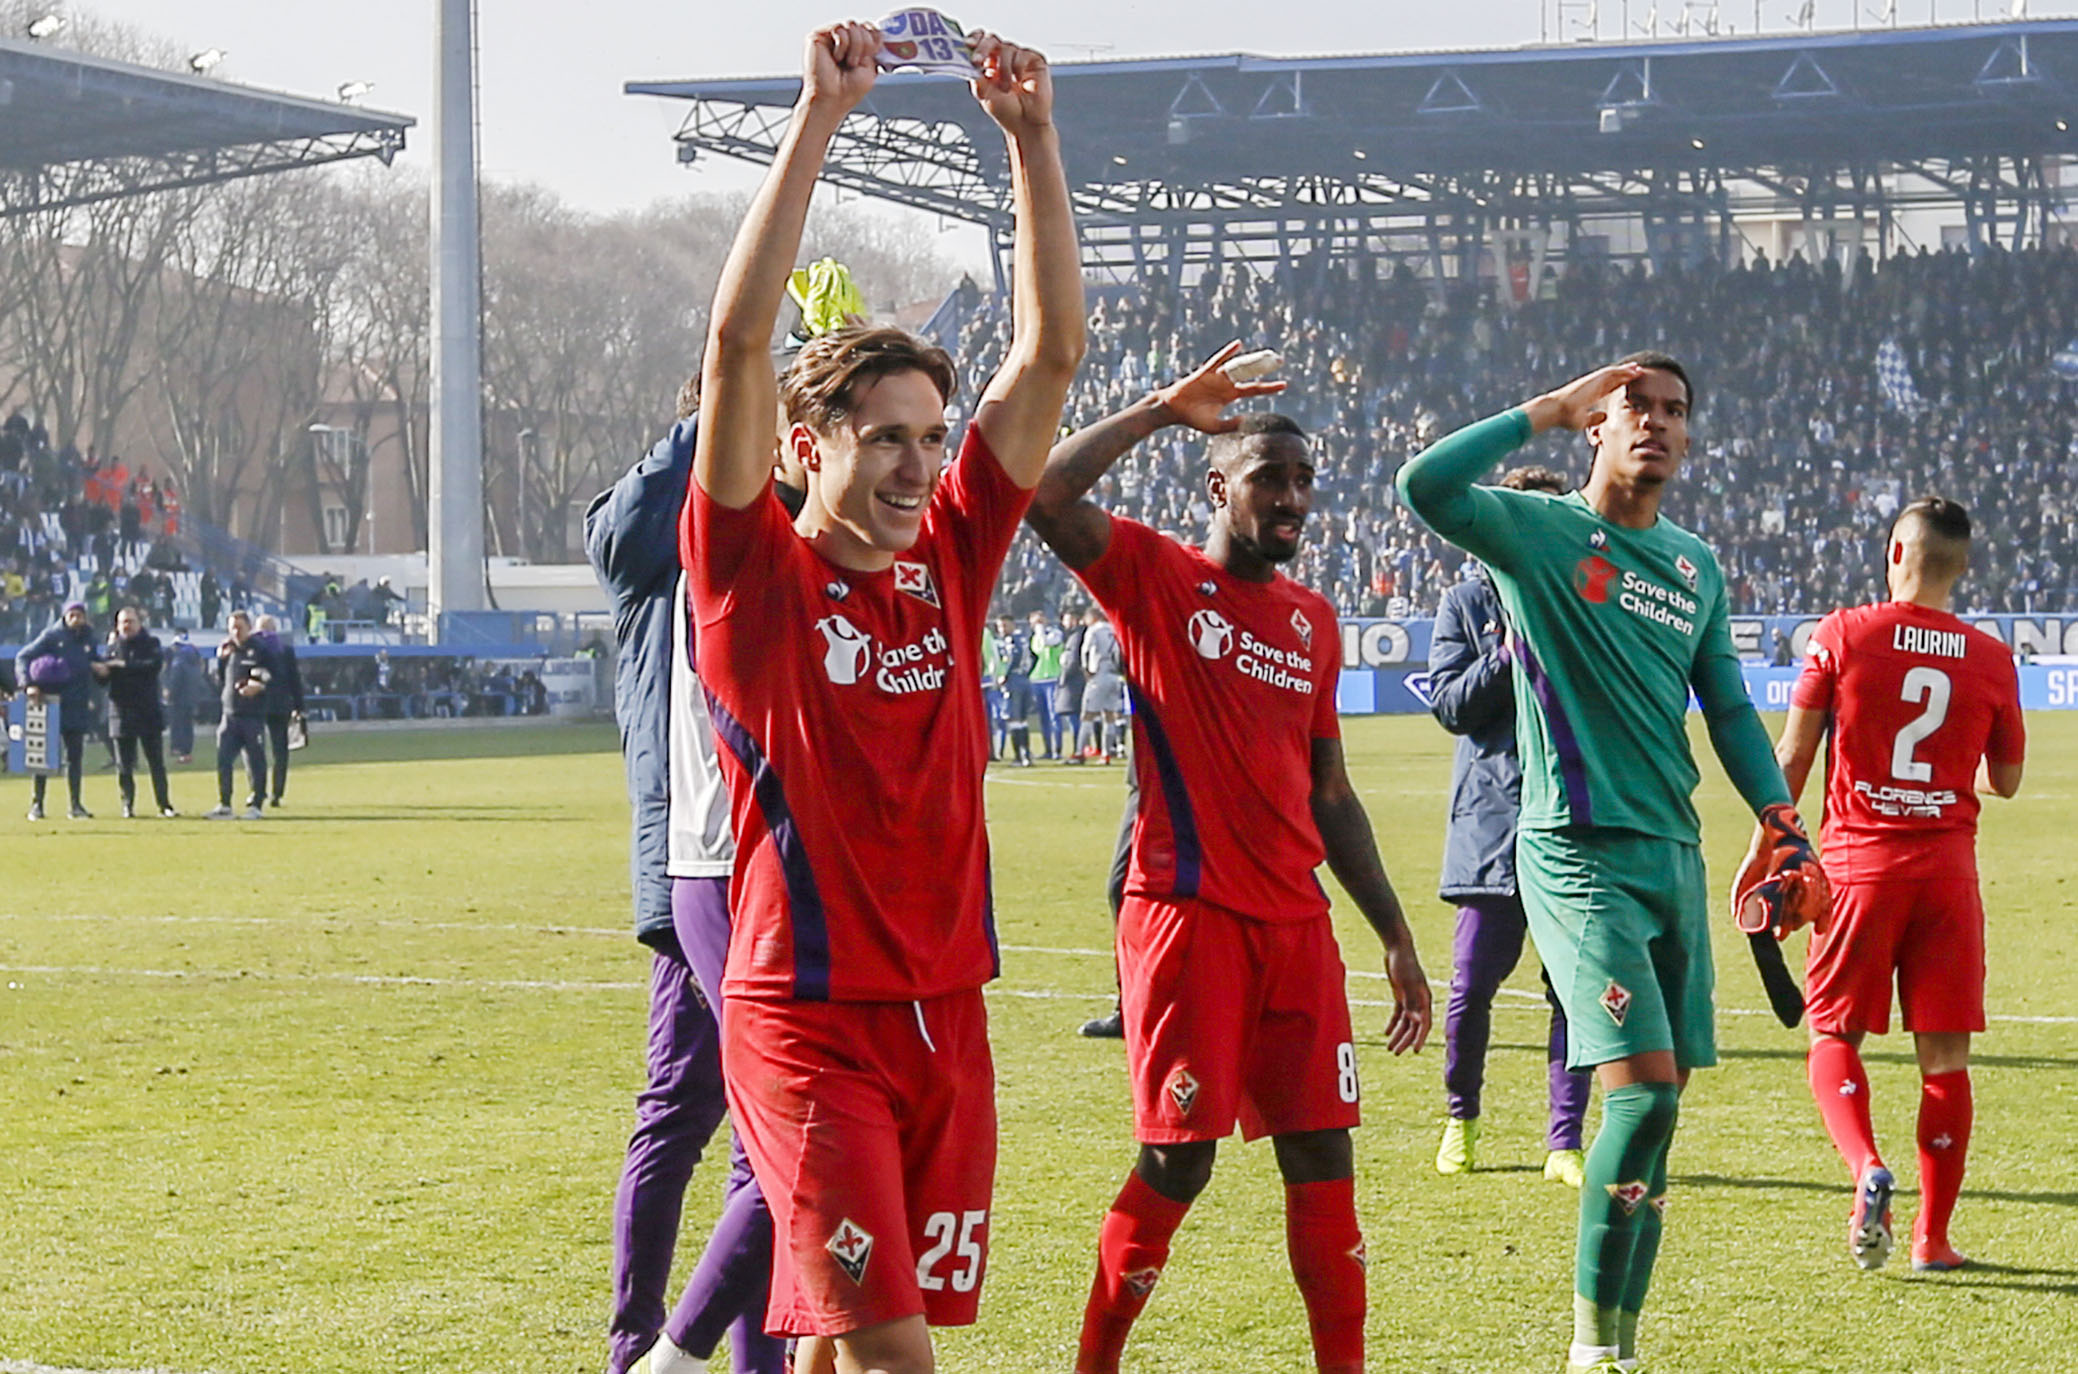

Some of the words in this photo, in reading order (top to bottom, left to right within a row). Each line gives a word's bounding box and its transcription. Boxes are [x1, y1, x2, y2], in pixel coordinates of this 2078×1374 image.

[908, 11, 948, 36] DA
[918, 37, 953, 61] 13
[1622, 571, 1667, 601] Save
[1668, 591, 1696, 614] the
[1619, 592, 1694, 636] Children
[1239, 631, 1284, 664] Save
[1286, 650, 1312, 672] the
[1343, 623, 1409, 667] IO
[1893, 624, 1966, 658] LAURINI
[1235, 654, 1312, 695] Children
[1891, 666, 1951, 782] 2
[1854, 780, 1957, 805] FLORENCE
[1871, 800, 1941, 818] 4EVER
[1337, 1042, 1358, 1103] 8
[916, 1209, 986, 1292] 25
